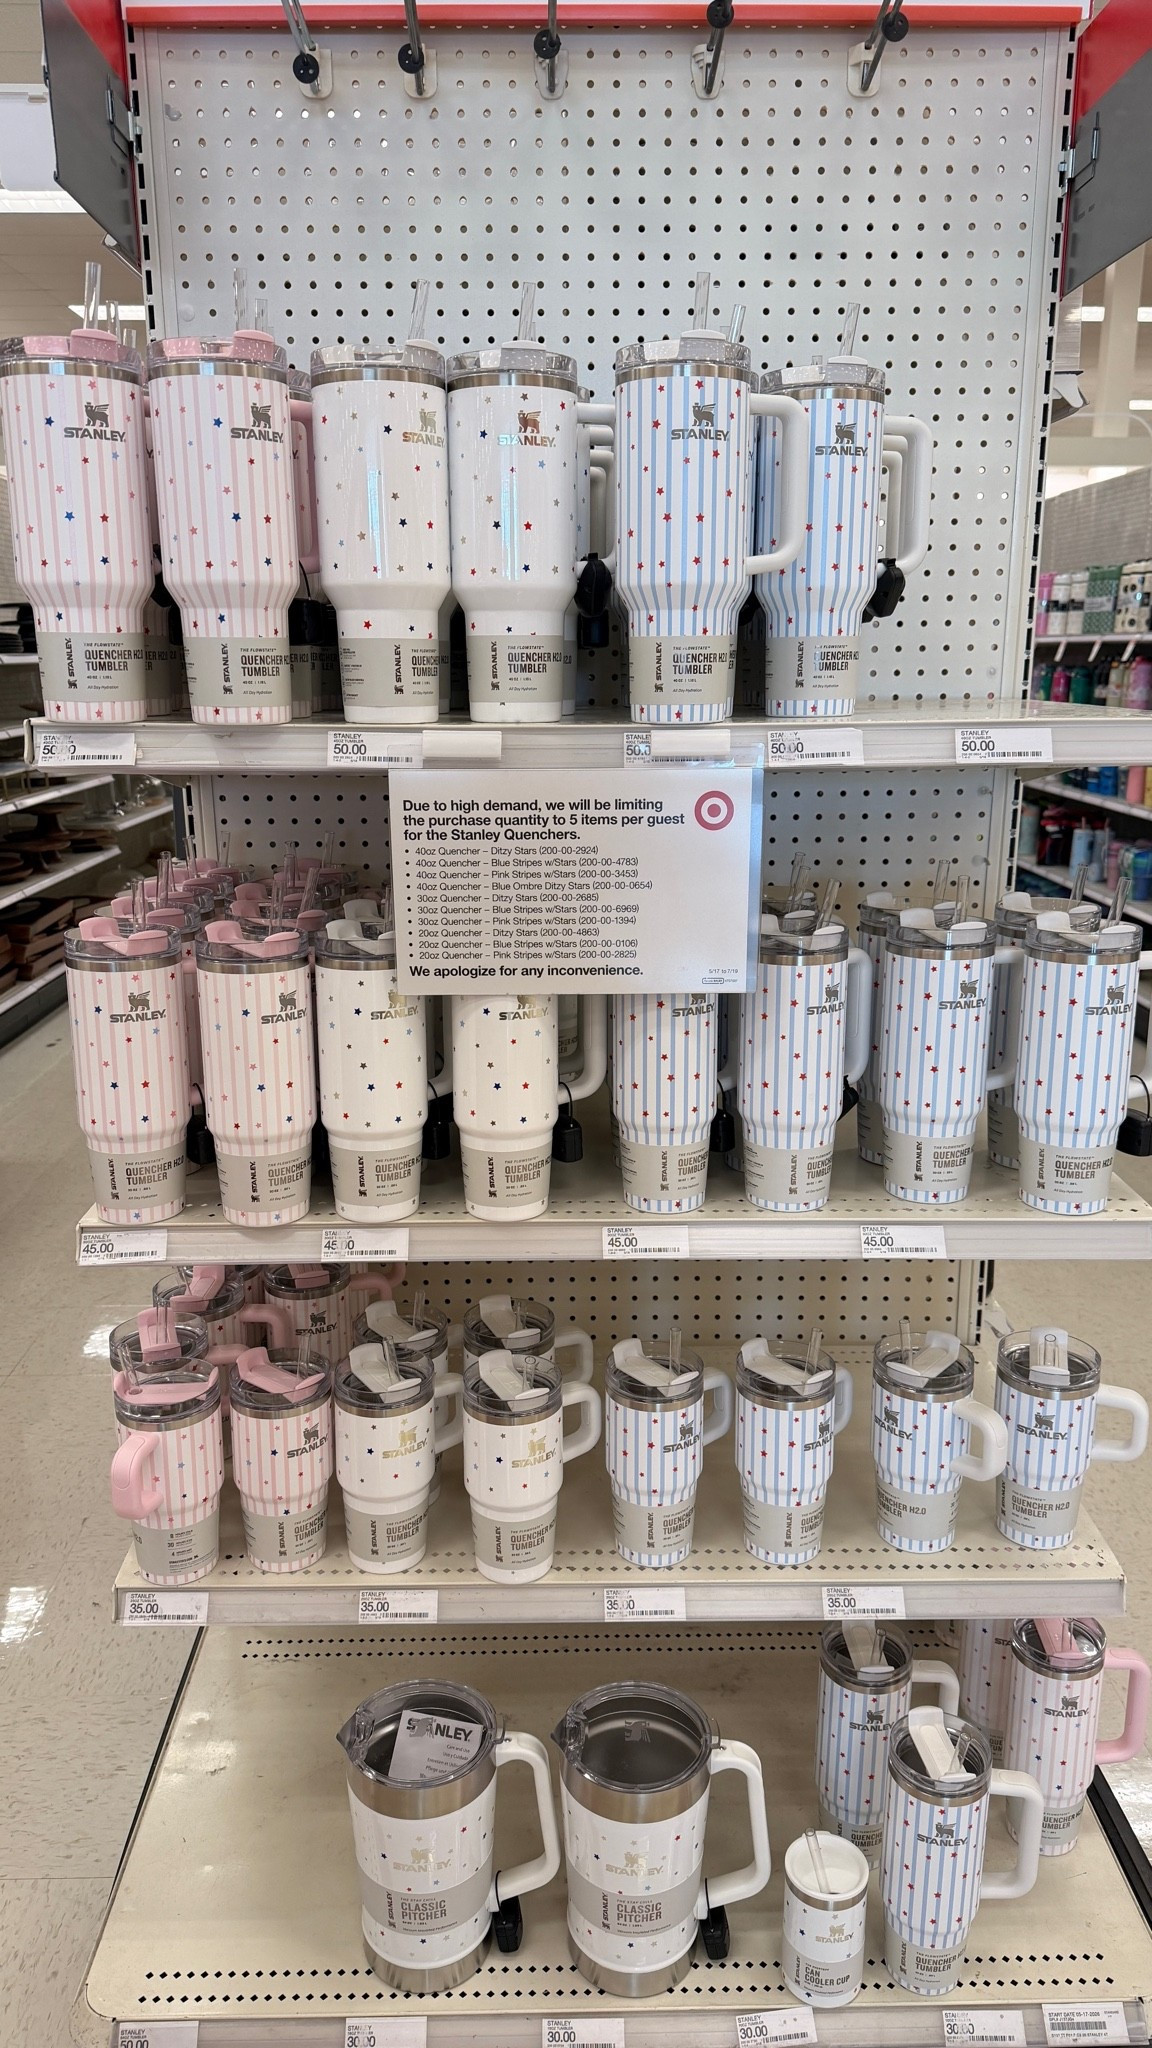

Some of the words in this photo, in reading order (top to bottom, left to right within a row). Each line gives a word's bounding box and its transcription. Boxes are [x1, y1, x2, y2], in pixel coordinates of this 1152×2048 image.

[85, 650, 132, 660] QUENCHER
[241, 654, 284, 665] QUENCHER
[508, 652, 551, 663] QUENCHER
[673, 653, 717, 664] QUENCHER
[86, 661, 128, 671] TUMBLER
[242, 666, 280, 676] TUMBLER
[508, 664, 547, 674] TUMBLER
[673, 664, 712, 674] TUMBLER
[333, 744, 367, 755] 50.00
[961, 740, 995, 751] 50.00
[403, 800, 429, 811] Due
[434, 800, 447, 811] to
[451, 799, 479, 813] high
[483, 799, 541, 812] demand,
[546, 802, 565, 810] we
[569, 799, 590, 810] will
[595, 799, 610, 810] be
[615, 799, 663, 812] limiting
[403, 814, 425, 826] the
[429, 814, 491, 828] purchase
[495, 814, 549, 828] quantity
[553, 815, 566, 825] to
[570, 814, 577, 825] 5
[582, 814, 617, 825] items
[622, 815, 644, 827] per
[647, 813, 685, 827] guest
[404, 829, 422, 840] for
[426, 829, 447, 840] the
[451, 829, 500, 842] Stanley
[504, 829, 580, 840] Quenchers.
[416, 847, 436, 855] 40oz
[439, 847, 480, 855] Quencher
[491, 847, 512, 856] Ditzy
[540, 846, 598, 855] (200-00-2924)
[416, 859, 436, 867] 40oz
[439, 859, 481, 867] Quencher
[492, 858, 510, 866] Blue
[513, 858, 542, 867] Stripes
[544, 858, 577, 866] w/Stars
[579, 858, 638, 866] (200-00-4783)
[416, 871, 436, 879] 40oz
[439, 871, 481, 879] Quencher
[492, 870, 509, 878] Pink
[512, 870, 542, 879] Stripes
[544, 870, 576, 878] w/Stars
[578, 870, 638, 878] (200-00-3453)
[417, 883, 437, 891] 40oz
[440, 883, 481, 891] Quencher
[513, 882, 542, 890] Ombre
[545, 882, 566, 891] Ditzy
[568, 882, 590, 890] Stars
[593, 881, 652, 890] (200-00-0654)
[440, 894, 482, 902] Quencher
[492, 894, 513, 903] Ditzy
[516, 894, 537, 902] Stars
[540, 893, 599, 902] (200-00-2685)
[418, 906, 438, 914] 30oz
[441, 906, 482, 914] Quencher
[514, 906, 542, 915] Stripes
[545, 905, 577, 913] w/Stars
[579, 905, 639, 913] (200-00-6969)
[418, 918, 438, 926] 30oz
[493, 917, 511, 925] Pink
[513, 917, 542, 926] Stripes
[545, 917, 576, 925] w/Stars
[579, 916, 636, 925] (200-00-1394)
[419, 929, 439, 937] 20oz
[441, 929, 482, 937] Quencher
[493, 929, 514, 938] Ditzy
[516, 929, 538, 937] Stars
[540, 928, 599, 937] (200-00-4863)
[442, 940, 482, 948] Quencher
[493, 940, 511, 948] Blue
[514, 940, 543, 949] Stripes
[546, 940, 577, 948] w/Stars
[579, 939, 638, 948] (200-00-0106)
[494, 951, 511, 959] Pink
[514, 951, 542, 960] Stripes
[545, 951, 577, 959] w/Stars
[579, 950, 636, 959] (200-00-2825)
[410, 966, 430, 976] We
[434, 965, 496, 978] apologize
[500, 965, 518, 976] for
[521, 967, 544, 978] any
[548, 964, 643, 976] inconvenience.
[933, 1148, 970, 1160] QUENCHER
[933, 1158, 966, 1168] TUMBLER
[1055, 1160, 1101, 1170] QUENCHER
[126, 1161, 172, 1176] QUENCHER
[126, 1172, 168, 1185] TUMBLER
[1055, 1169, 1095, 1179] TUMBLER
[608, 1237, 638, 1247] 45.00
[864, 1236, 894, 1246] 45.00
[82, 1243, 114, 1254] 45.00
[1012, 1495, 1054, 1511] QUENCHER
[1012, 1503, 1048, 1519] TUMBLER
[361, 1602, 389, 1612] 35.00
[828, 1598, 856, 1608] 35.00
[130, 1604, 158, 1613] 35.00
[401, 1900, 446, 1912] CLASSIC
[617, 1902, 662, 1914] CLASSIC
[402, 1908, 446, 1920] PITCHER
[617, 1911, 662, 1923] PITCHER
[805, 1966, 820, 1977] CAN
[805, 1974, 835, 1986] COOLER
[836, 1975, 850, 1984] CUP
[547, 2031, 576, 2042] 30.00
[740, 2025, 768, 2039] 30.00
